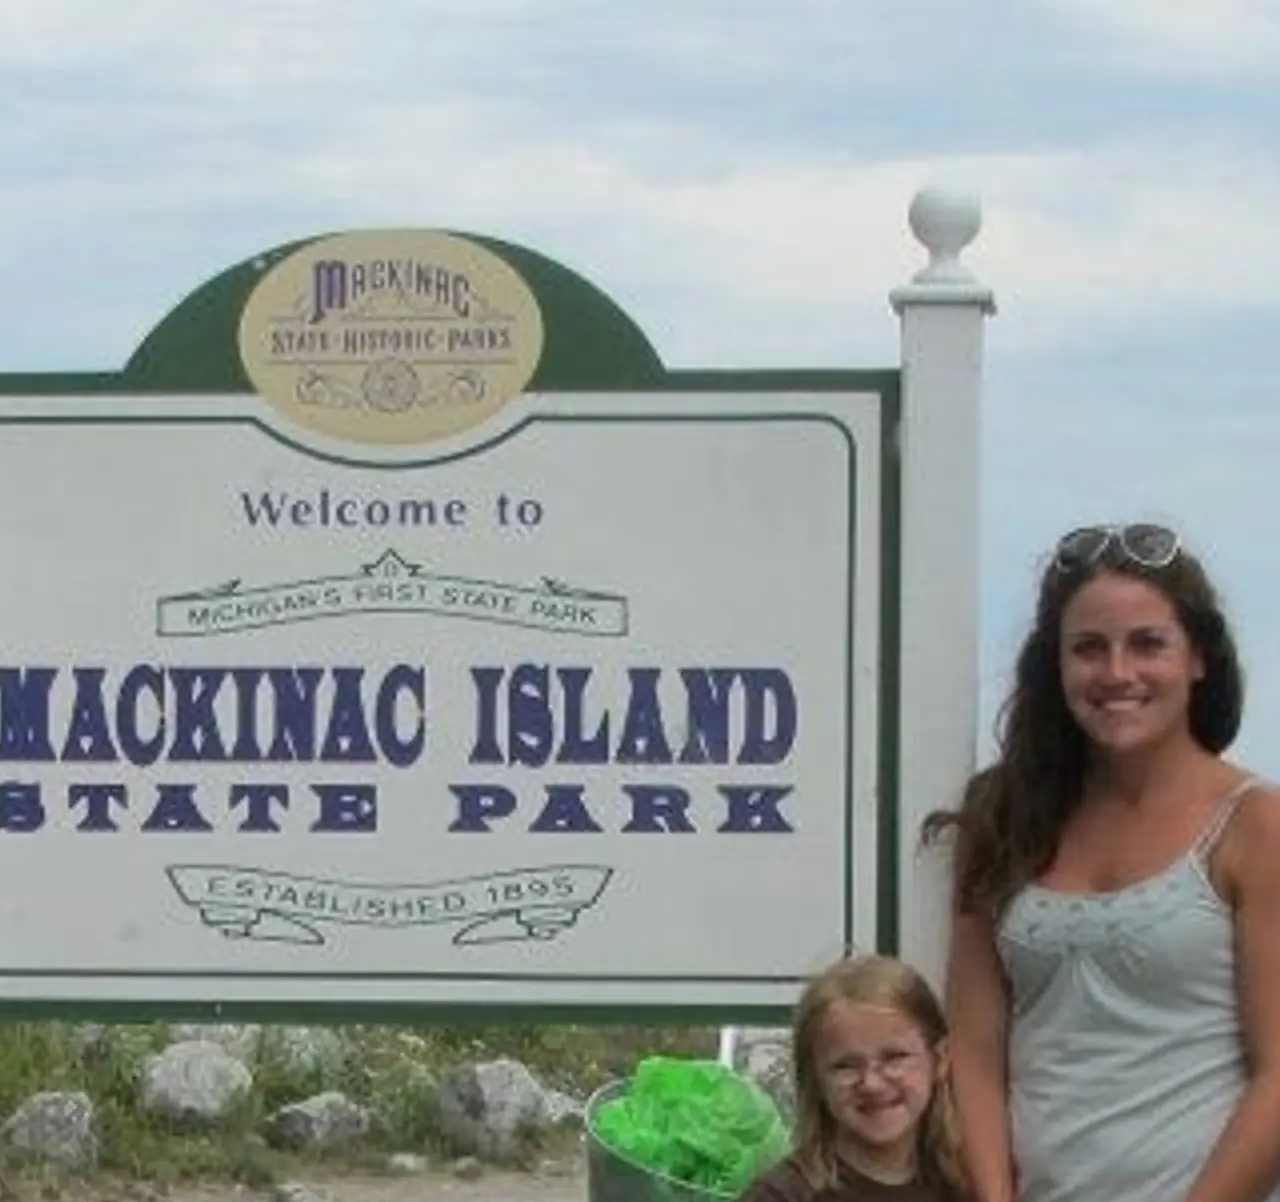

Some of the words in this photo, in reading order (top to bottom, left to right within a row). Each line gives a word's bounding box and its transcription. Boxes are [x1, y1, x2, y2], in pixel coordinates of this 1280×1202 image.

[308, 256, 471, 325] MACKINAC
[271, 328, 329, 355] STATE
[343, 328, 437, 355] HISTORIC
[447, 327, 512, 353] PARKS
[240, 489, 468, 528] Welcome
[496, 491, 544, 527] to
[186, 585, 343, 625] MICHIGAN'S
[353, 583, 428, 602] FIRST
[443, 585, 517, 613] STATE
[529, 600, 598, 626] PARK
[466, 663, 799, 768] ISLAND
[446, 783, 797, 833] PARK
[206, 878, 466, 919] ESTABLISHED
[486, 878, 576, 904] 1895
